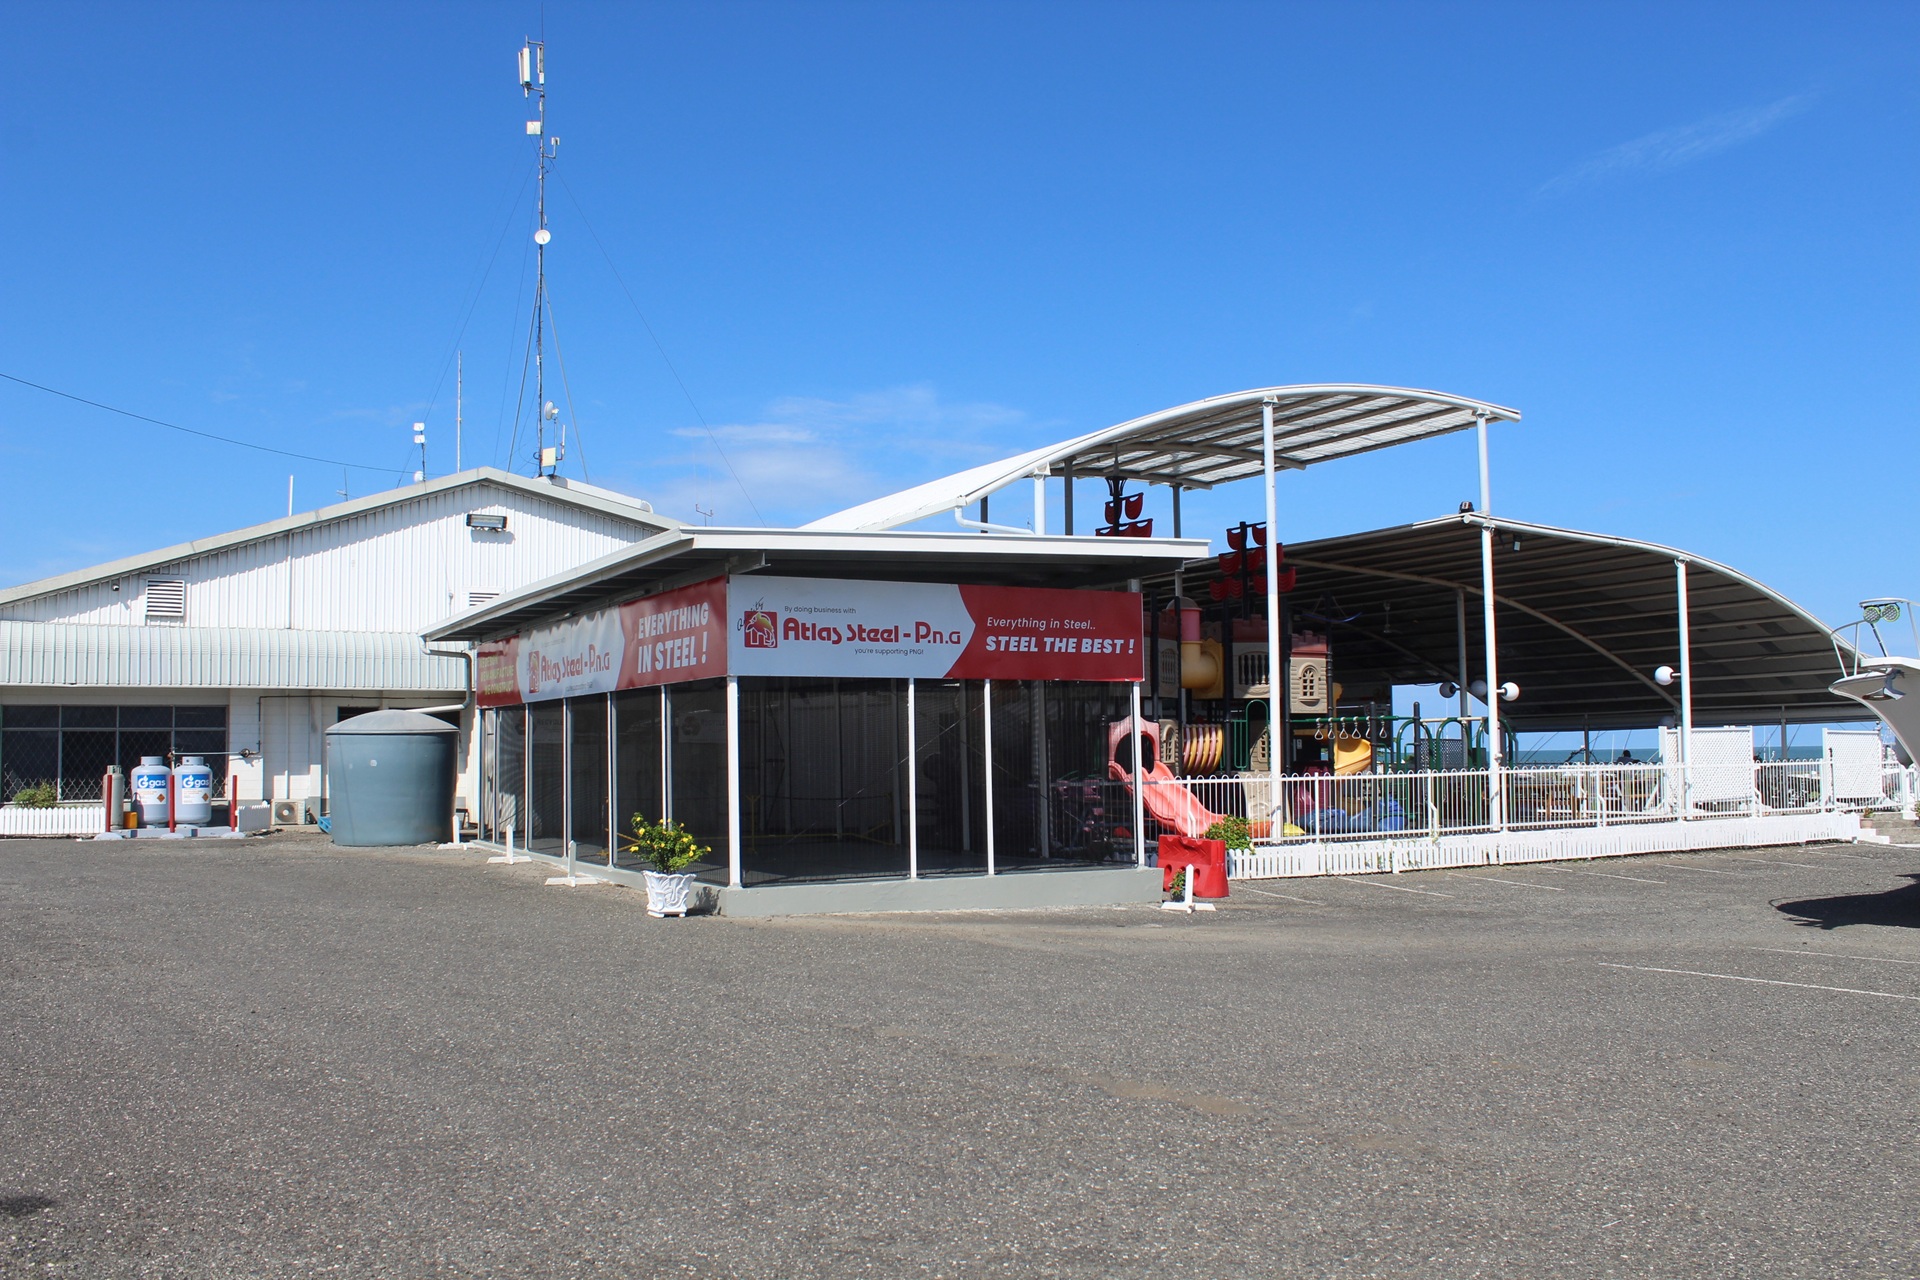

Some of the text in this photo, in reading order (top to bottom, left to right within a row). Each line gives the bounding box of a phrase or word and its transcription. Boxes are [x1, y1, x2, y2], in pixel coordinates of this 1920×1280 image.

[638, 602, 709, 639] EVERYTHING
[784, 605, 792, 613] By
[793, 606, 812, 614] doing
[814, 606, 842, 614] business
[783, 617, 843, 645] Atlas
[846, 624, 899, 643] Steel
[987, 616, 1046, 631] Everything
[1050, 618, 1060, 629] in
[637, 644, 652, 674] IN
[655, 635, 697, 671] STEEL
[875, 648, 908, 656] supporting
[986, 635, 1135, 654] STEEL THE BEST !
[541, 655, 561, 683] Atlas
[562, 652, 583, 678] Steel
